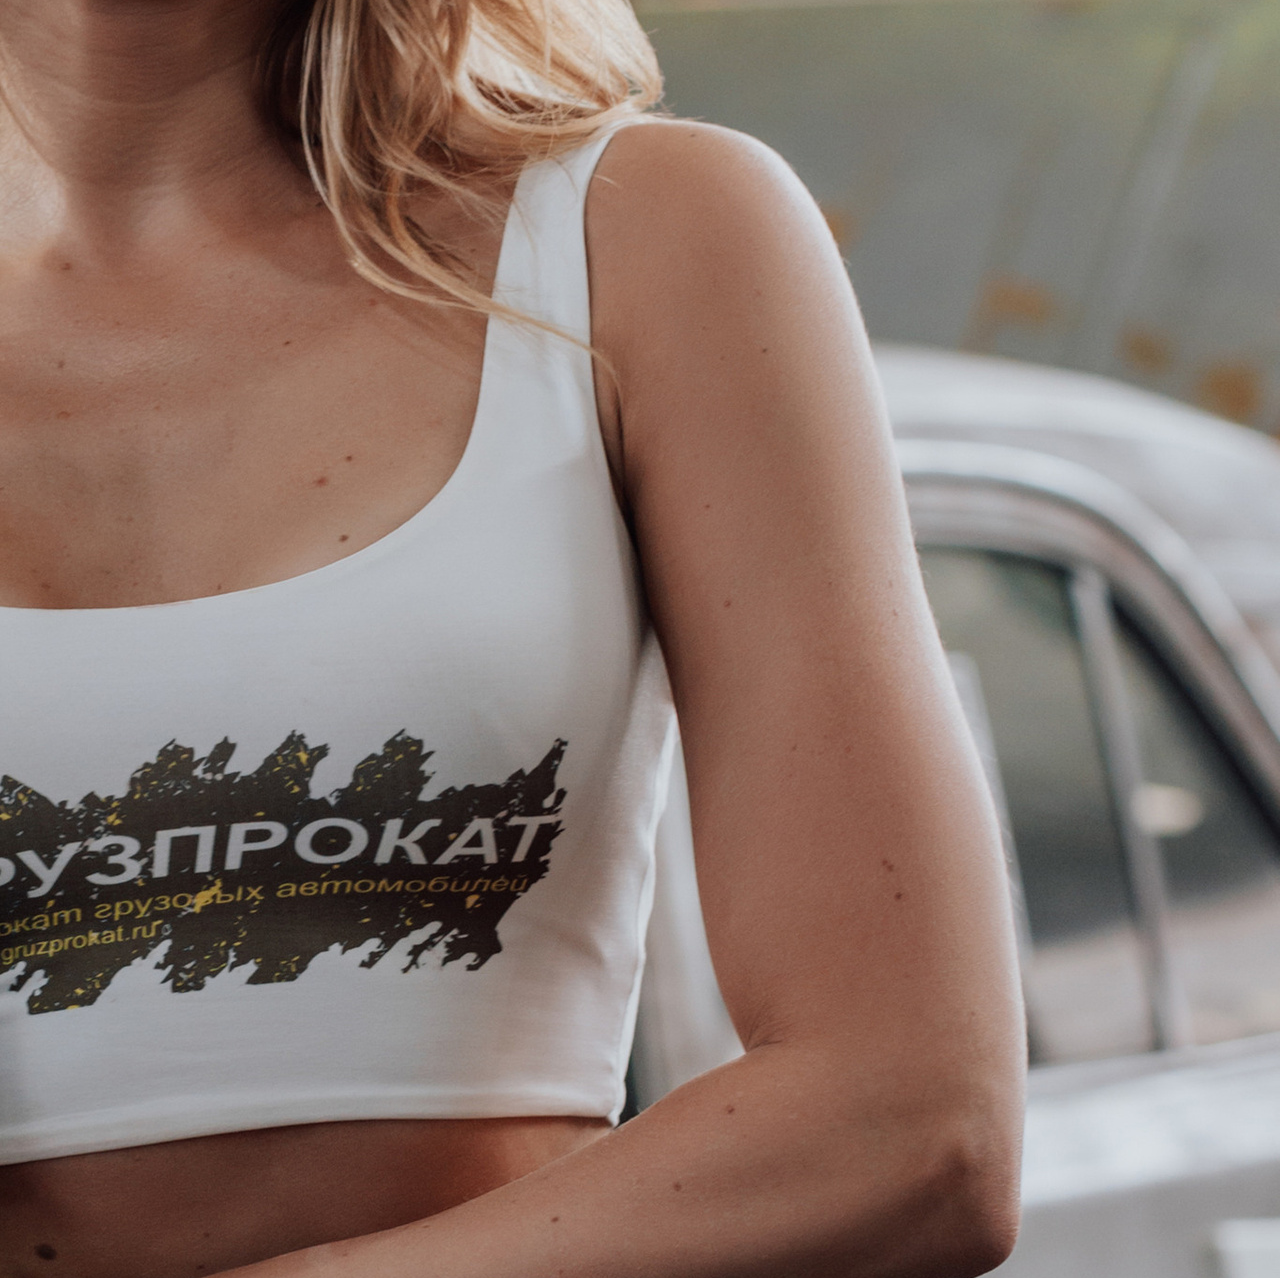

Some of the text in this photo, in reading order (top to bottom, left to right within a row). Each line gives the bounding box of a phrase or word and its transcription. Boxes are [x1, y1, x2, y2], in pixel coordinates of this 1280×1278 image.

[94, 882, 265, 921] грузовых
[276, 873, 529, 899] автомобилей
[0, 919, 163, 965] gruzprokat.ru
